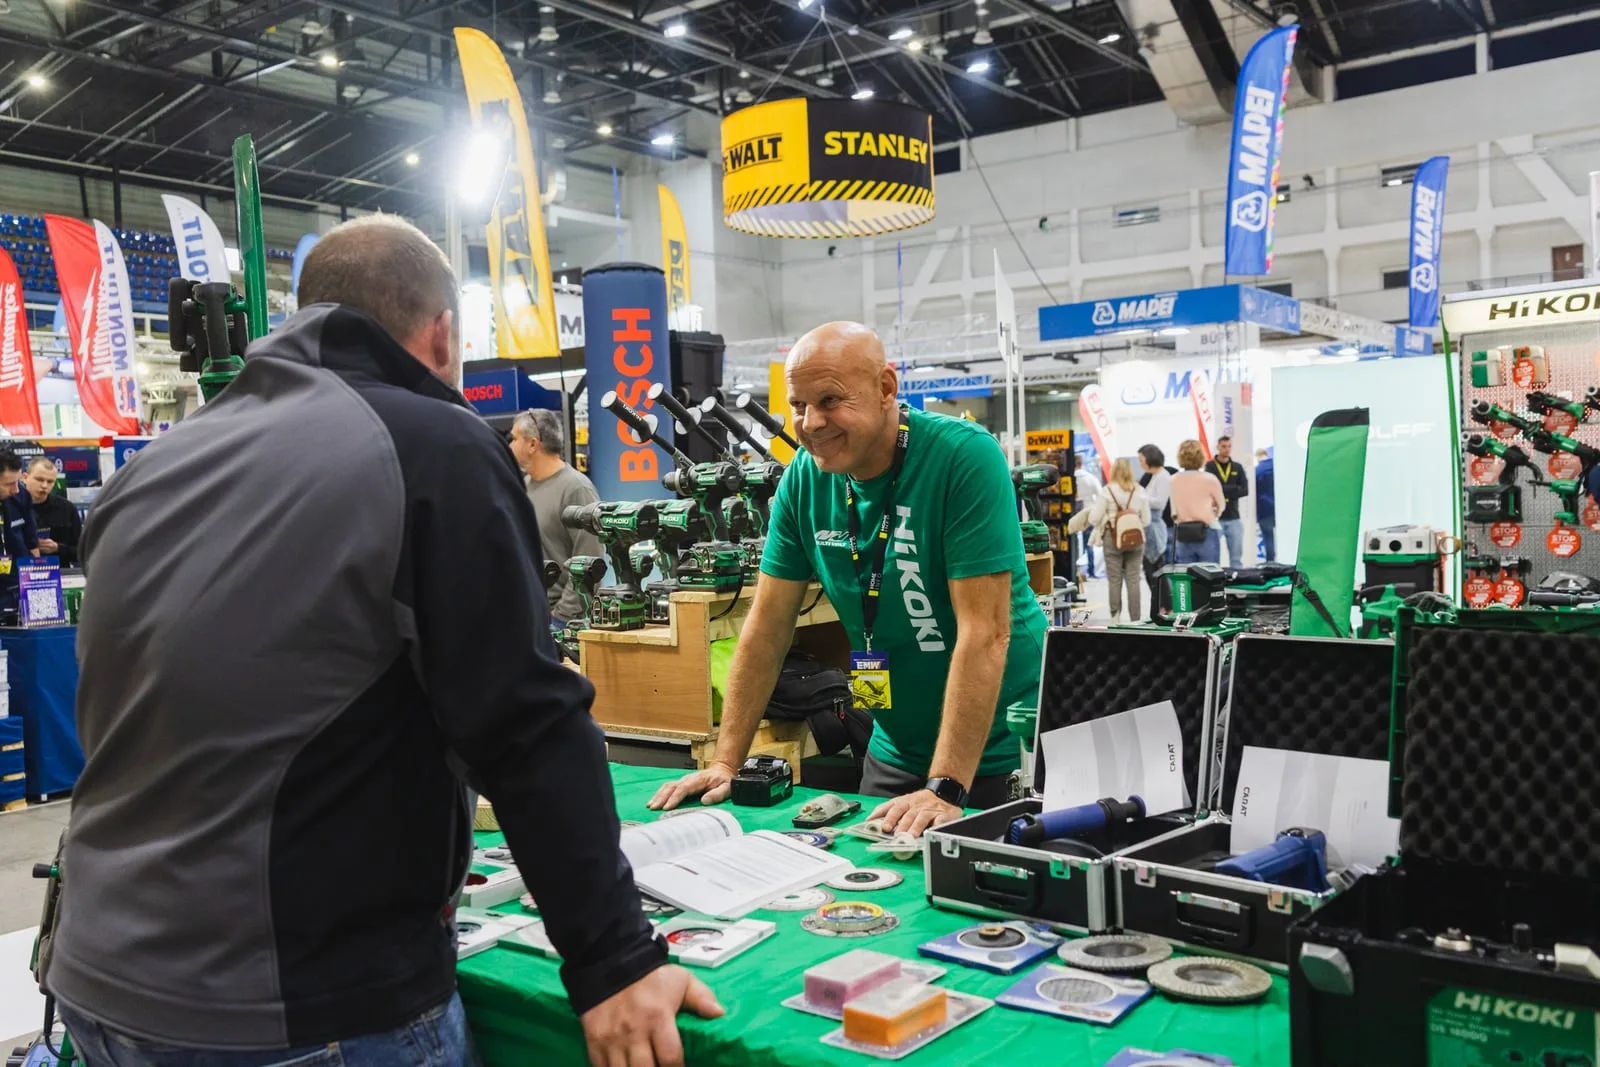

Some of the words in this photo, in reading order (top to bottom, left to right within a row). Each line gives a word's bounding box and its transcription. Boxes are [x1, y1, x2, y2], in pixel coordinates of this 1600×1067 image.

[823, 130, 928, 165] STANLEY
[1237, 85, 1276, 187] MAPEI
[1414, 182, 1437, 261] MAPEI
[1118, 296, 1178, 321] MAPEI
[464, 384, 503, 400] BOSCH
[612, 308, 658, 482] BOSCH
[894, 504, 946, 652] HiKOKI
[856, 661, 881, 670] EMW
[1454, 991, 1576, 1030] HiKOKI
